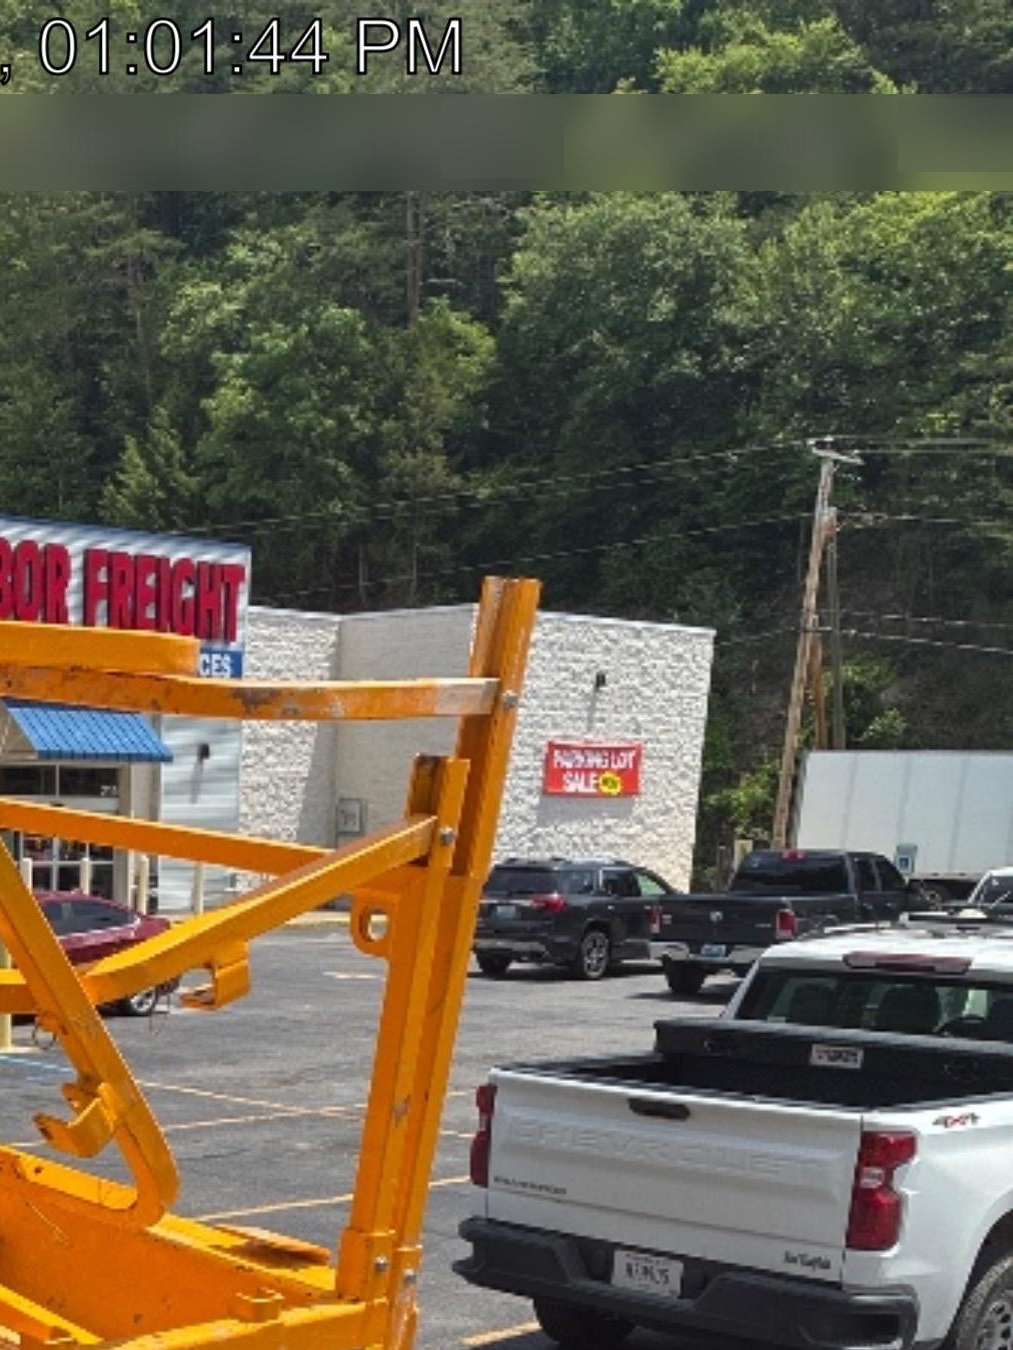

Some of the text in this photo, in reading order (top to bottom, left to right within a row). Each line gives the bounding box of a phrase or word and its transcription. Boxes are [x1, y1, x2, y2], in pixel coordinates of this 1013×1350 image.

[83, 547, 247, 645] FREIGHT
[199, 652, 231, 677] CES
[611, 750, 637, 769] LOT
[563, 770, 598, 793] SALE
